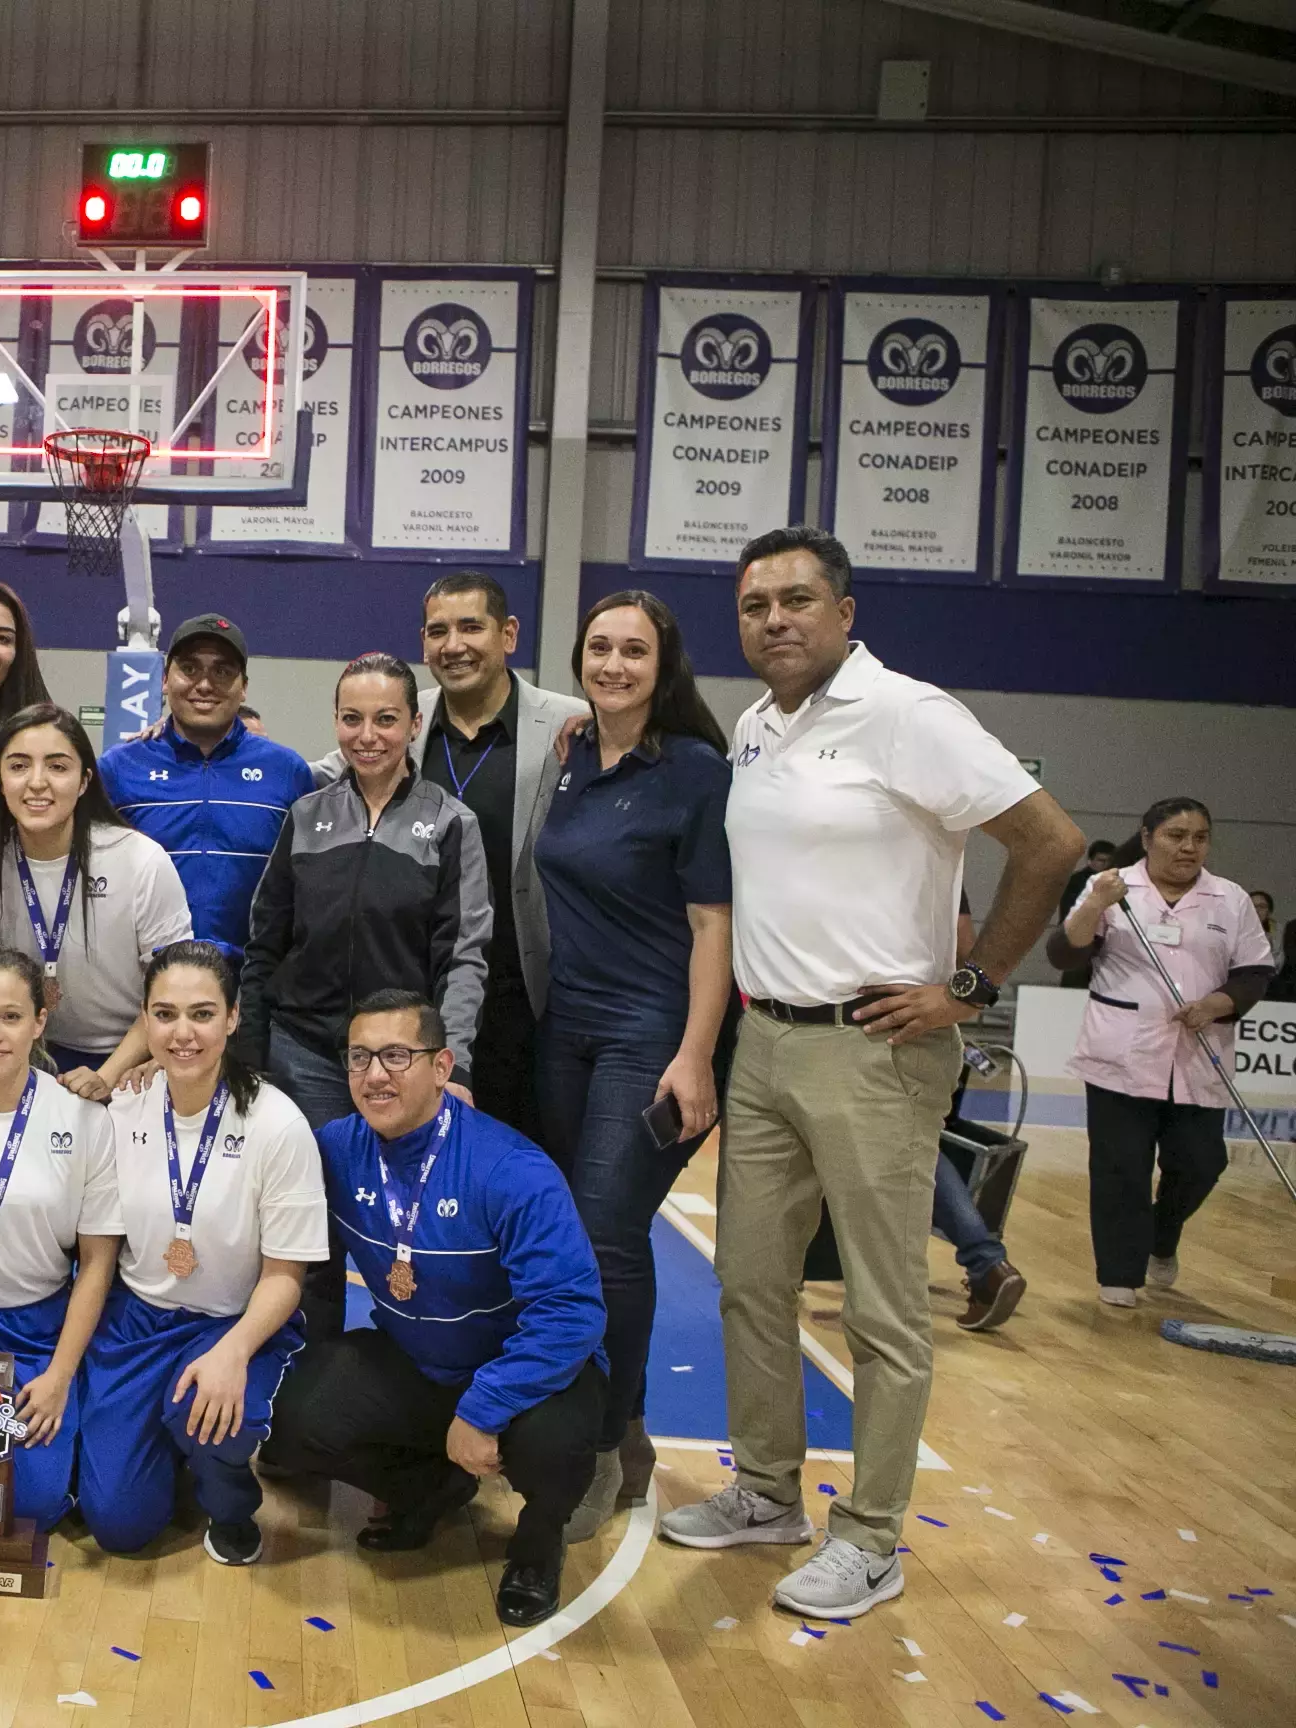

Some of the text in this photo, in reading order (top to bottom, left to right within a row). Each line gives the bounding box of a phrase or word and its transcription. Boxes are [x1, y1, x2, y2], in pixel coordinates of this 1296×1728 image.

[109, 153, 165, 178] 00.0
[413, 361, 481, 375] BORREGOS
[690, 371, 760, 386] BORREGOS
[877, 376, 949, 391] BORREGOS
[1062, 384, 1135, 398] BORREGOS
[388, 405, 503, 421] CAMPEONES
[663, 413, 781, 432] CAMPEONES
[849, 420, 970, 438] CAMPEONES
[1036, 426, 1160, 445] CAMPEONES
[380, 437, 509, 453] INTERCAMPUS
[672, 446, 769, 464] CONADEIP
[859, 453, 958, 470] CONADEIP
[420, 470, 465, 484] 2009
[1046, 460, 1147, 478] CONADEIP
[695, 480, 741, 496] 2009
[883, 488, 929, 503] 2008
[1071, 495, 1118, 511] 2008
[241, 516, 315, 525] VARONIL MAYOR
[410, 510, 473, 519] BALONCESTO
[403, 524, 479, 533] VARONIL MAYOR
[684, 521, 748, 532] BALONCESTO
[676, 534, 717, 544] FEMENIL
[871, 530, 936, 540] BALONCESTO
[1057, 537, 1124, 547] BALONCESTO
[214, 1088, 228, 1118] SPALDING
[7, 1132, 21, 1160] SPALDING
[199, 1135, 213, 1164] SPALDING
[172, 1179, 181, 1208] SPALDING
[186, 1182, 198, 1211] SPALDING
